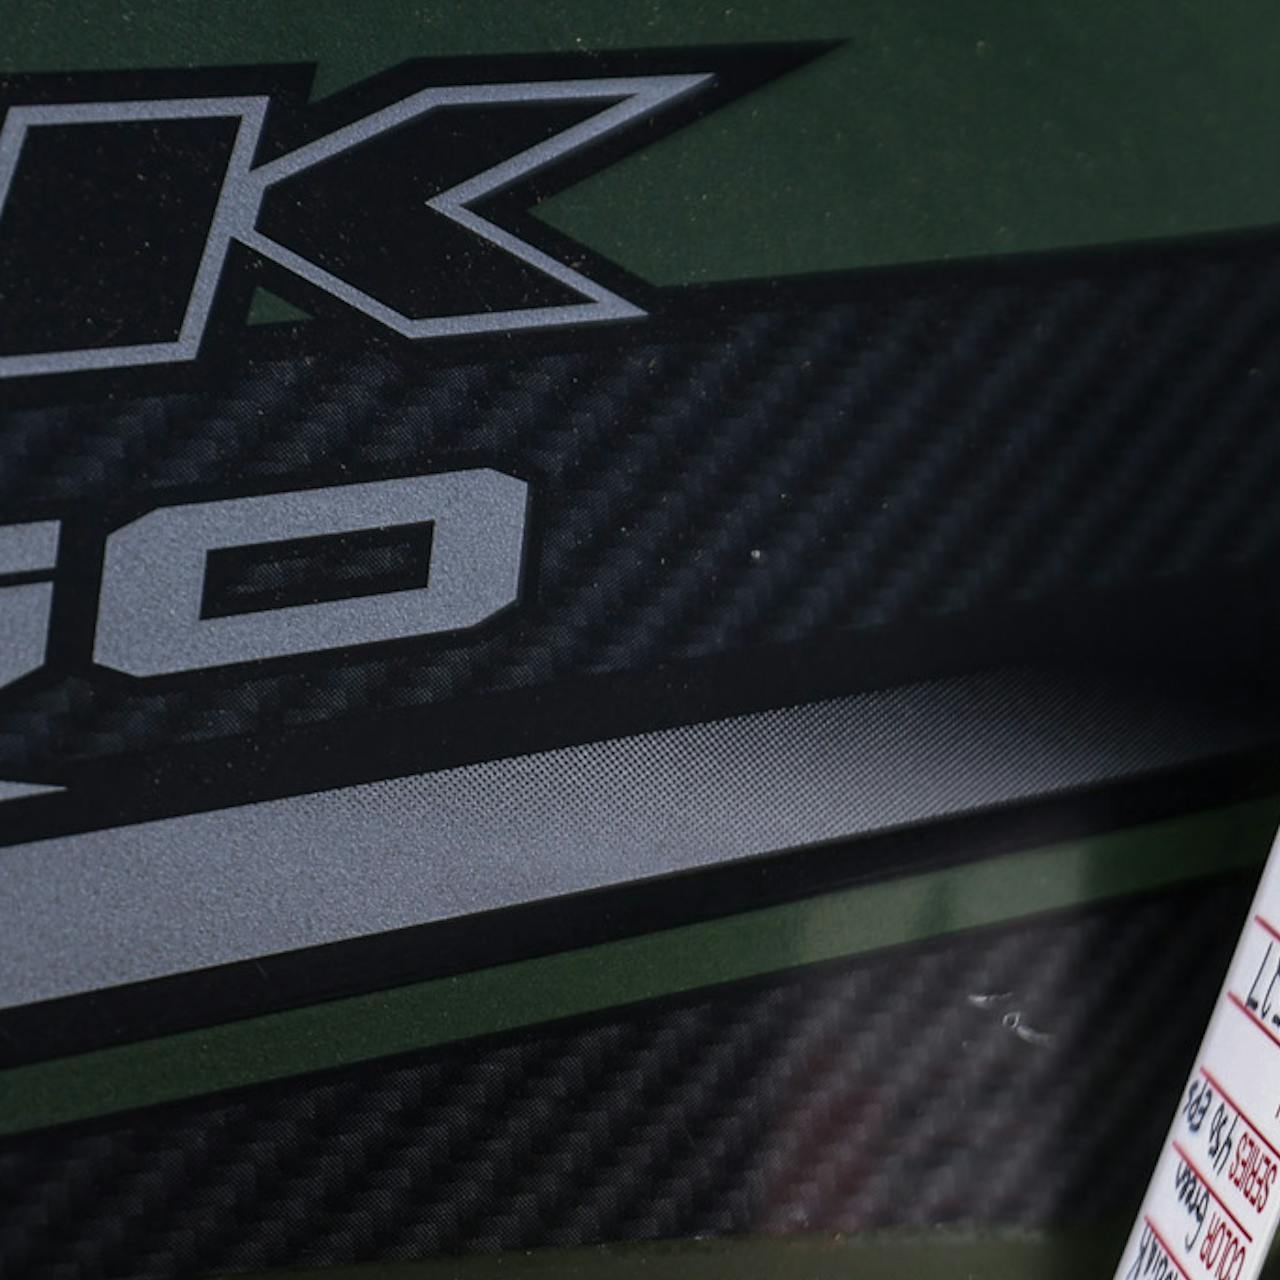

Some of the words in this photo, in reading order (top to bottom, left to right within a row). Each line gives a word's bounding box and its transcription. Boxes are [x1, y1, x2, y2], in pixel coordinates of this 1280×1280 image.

[0, 467, 528, 690] 0
[1208, 1100, 1239, 1176] 450
[1228, 1134, 1278, 1213] SERIES
[1176, 1159, 1210, 1251] Green
